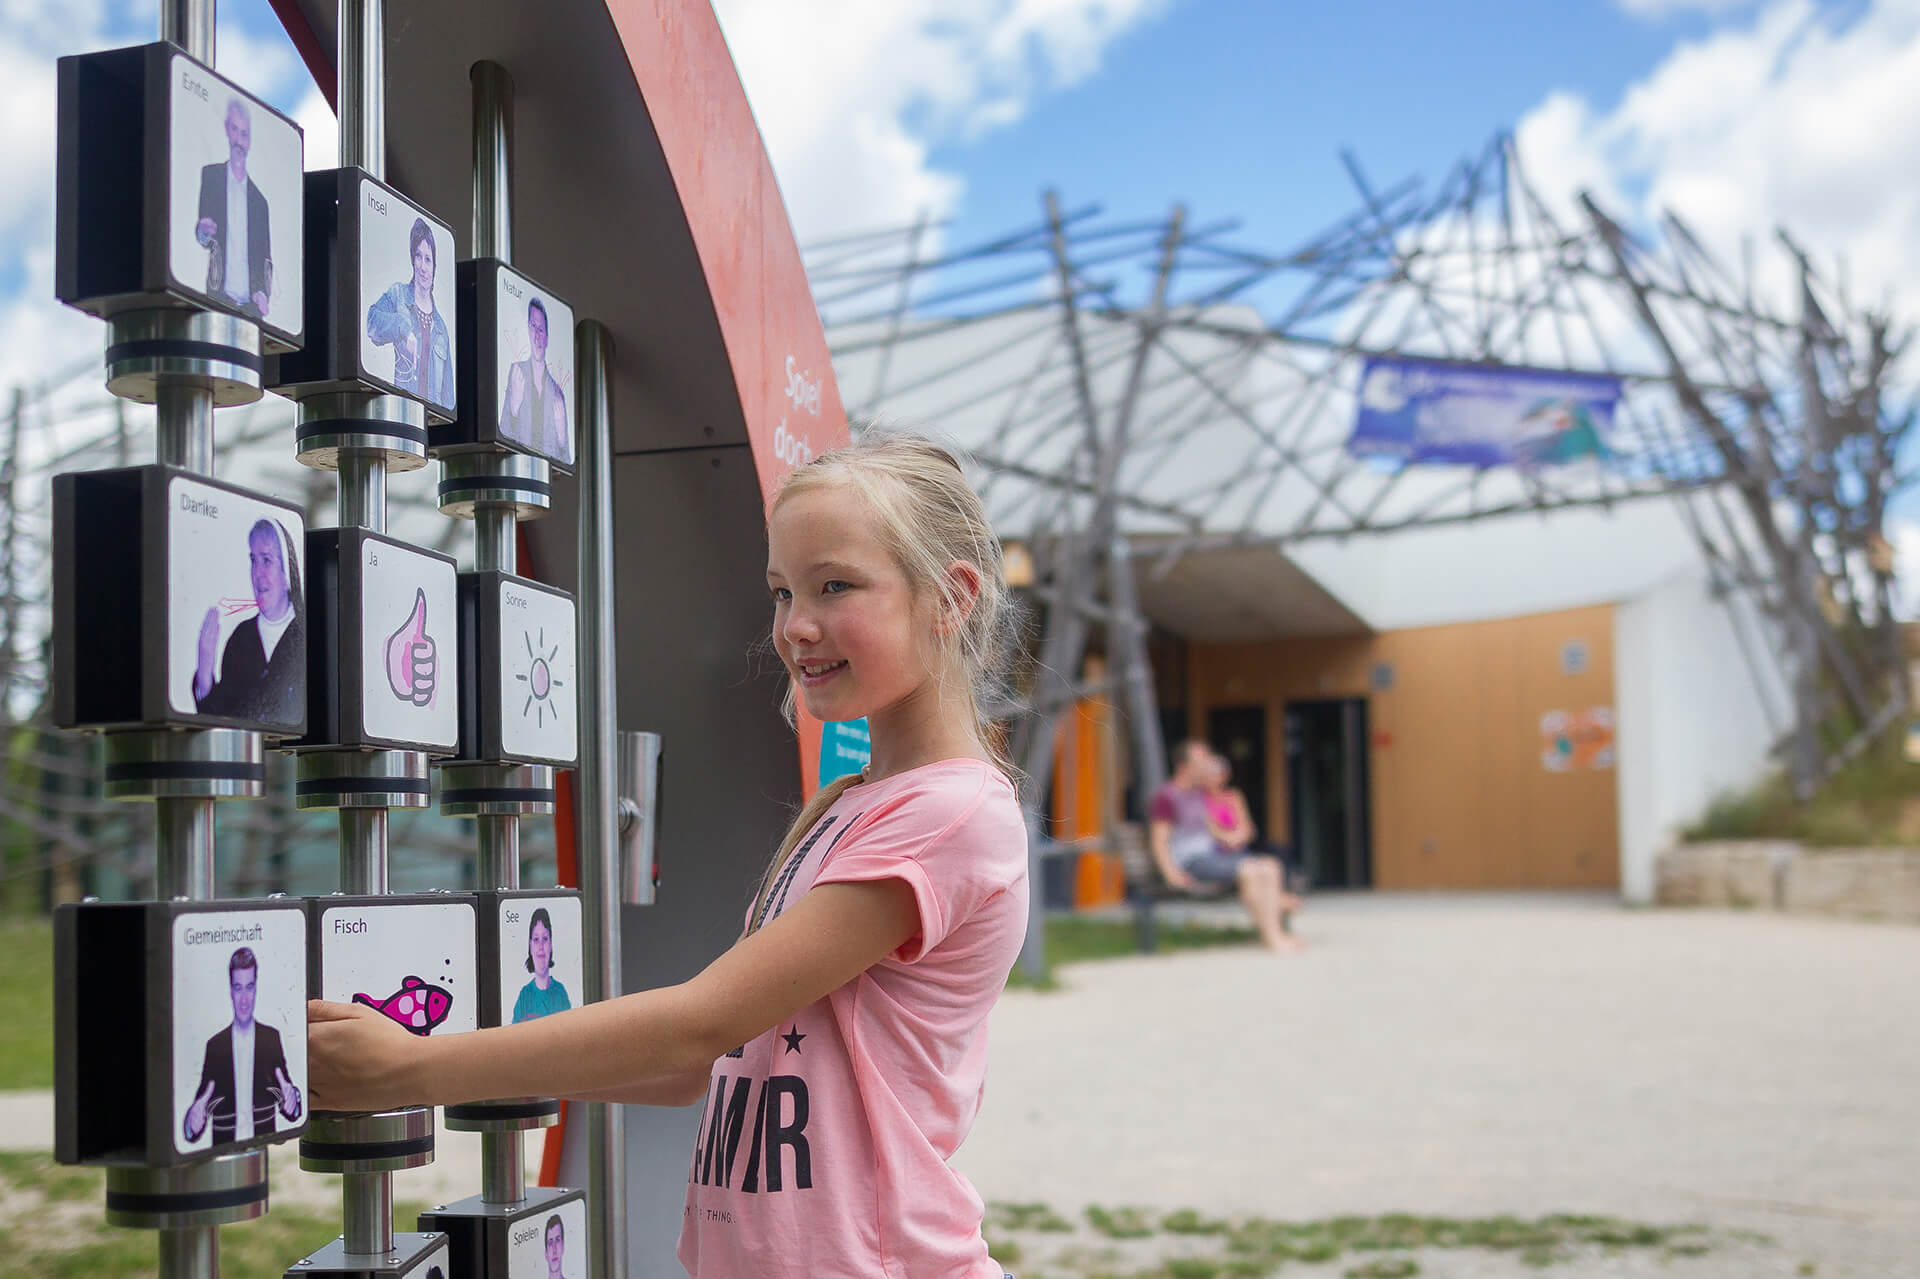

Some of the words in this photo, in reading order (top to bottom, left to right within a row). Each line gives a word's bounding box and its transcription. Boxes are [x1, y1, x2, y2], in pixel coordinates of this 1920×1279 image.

[367, 192, 388, 217] Insel
[503, 278, 524, 299] Natur
[783, 353, 822, 418] Spiel
[181, 493, 219, 520] Danke
[369, 551, 378, 567] Ja
[505, 591, 528, 609] Sonne
[334, 917, 368, 934] Fisch
[505, 909, 520, 924] See
[184, 922, 264, 945] Gemeinschaft
[513, 1226, 540, 1248] Spielen
